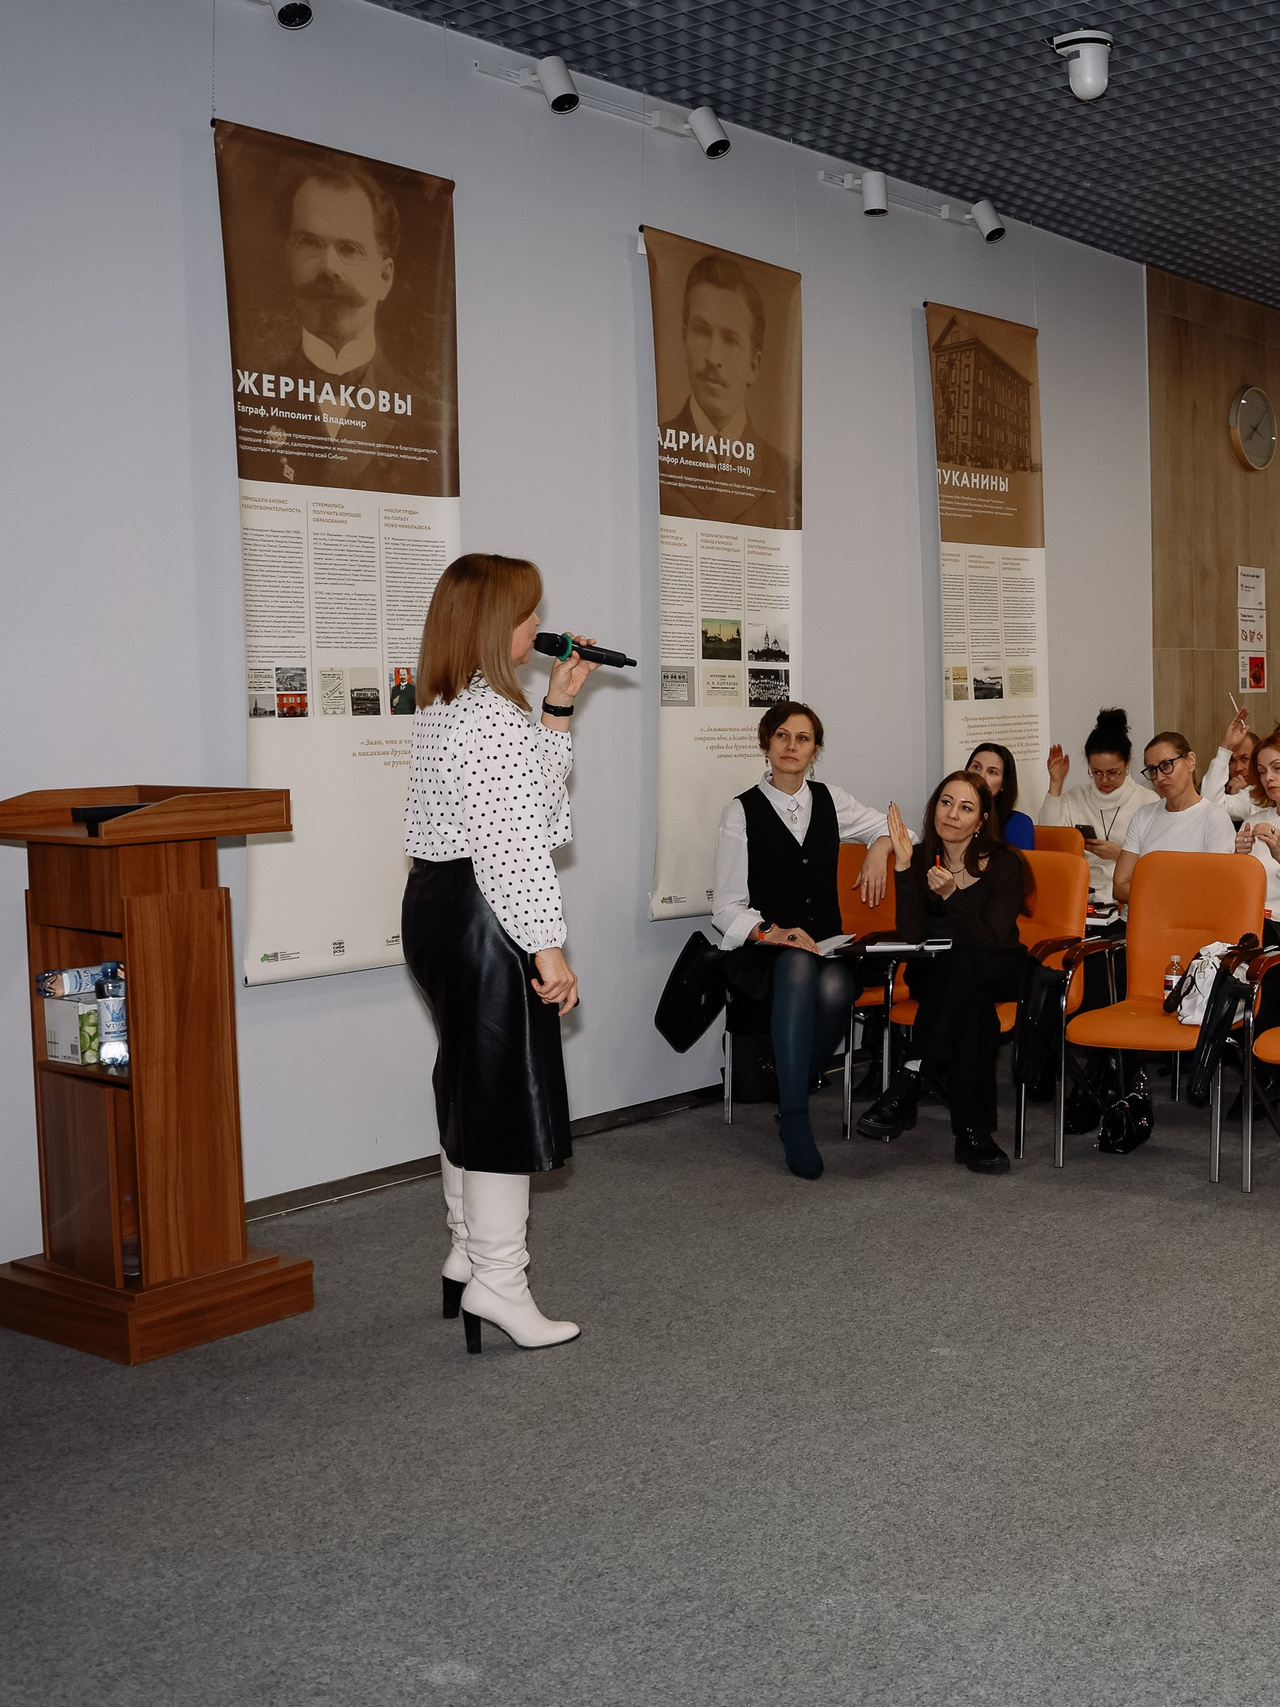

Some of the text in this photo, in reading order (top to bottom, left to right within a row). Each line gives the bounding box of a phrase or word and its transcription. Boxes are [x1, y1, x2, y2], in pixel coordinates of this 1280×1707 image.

[236, 369, 412, 416] ЖЕРНАКОВЫ
[237, 401, 269, 417] Евграф,
[270, 407, 312, 422] Ипполит
[322, 413, 367, 429] Владимир
[679, 456, 717, 470] Алексеевич
